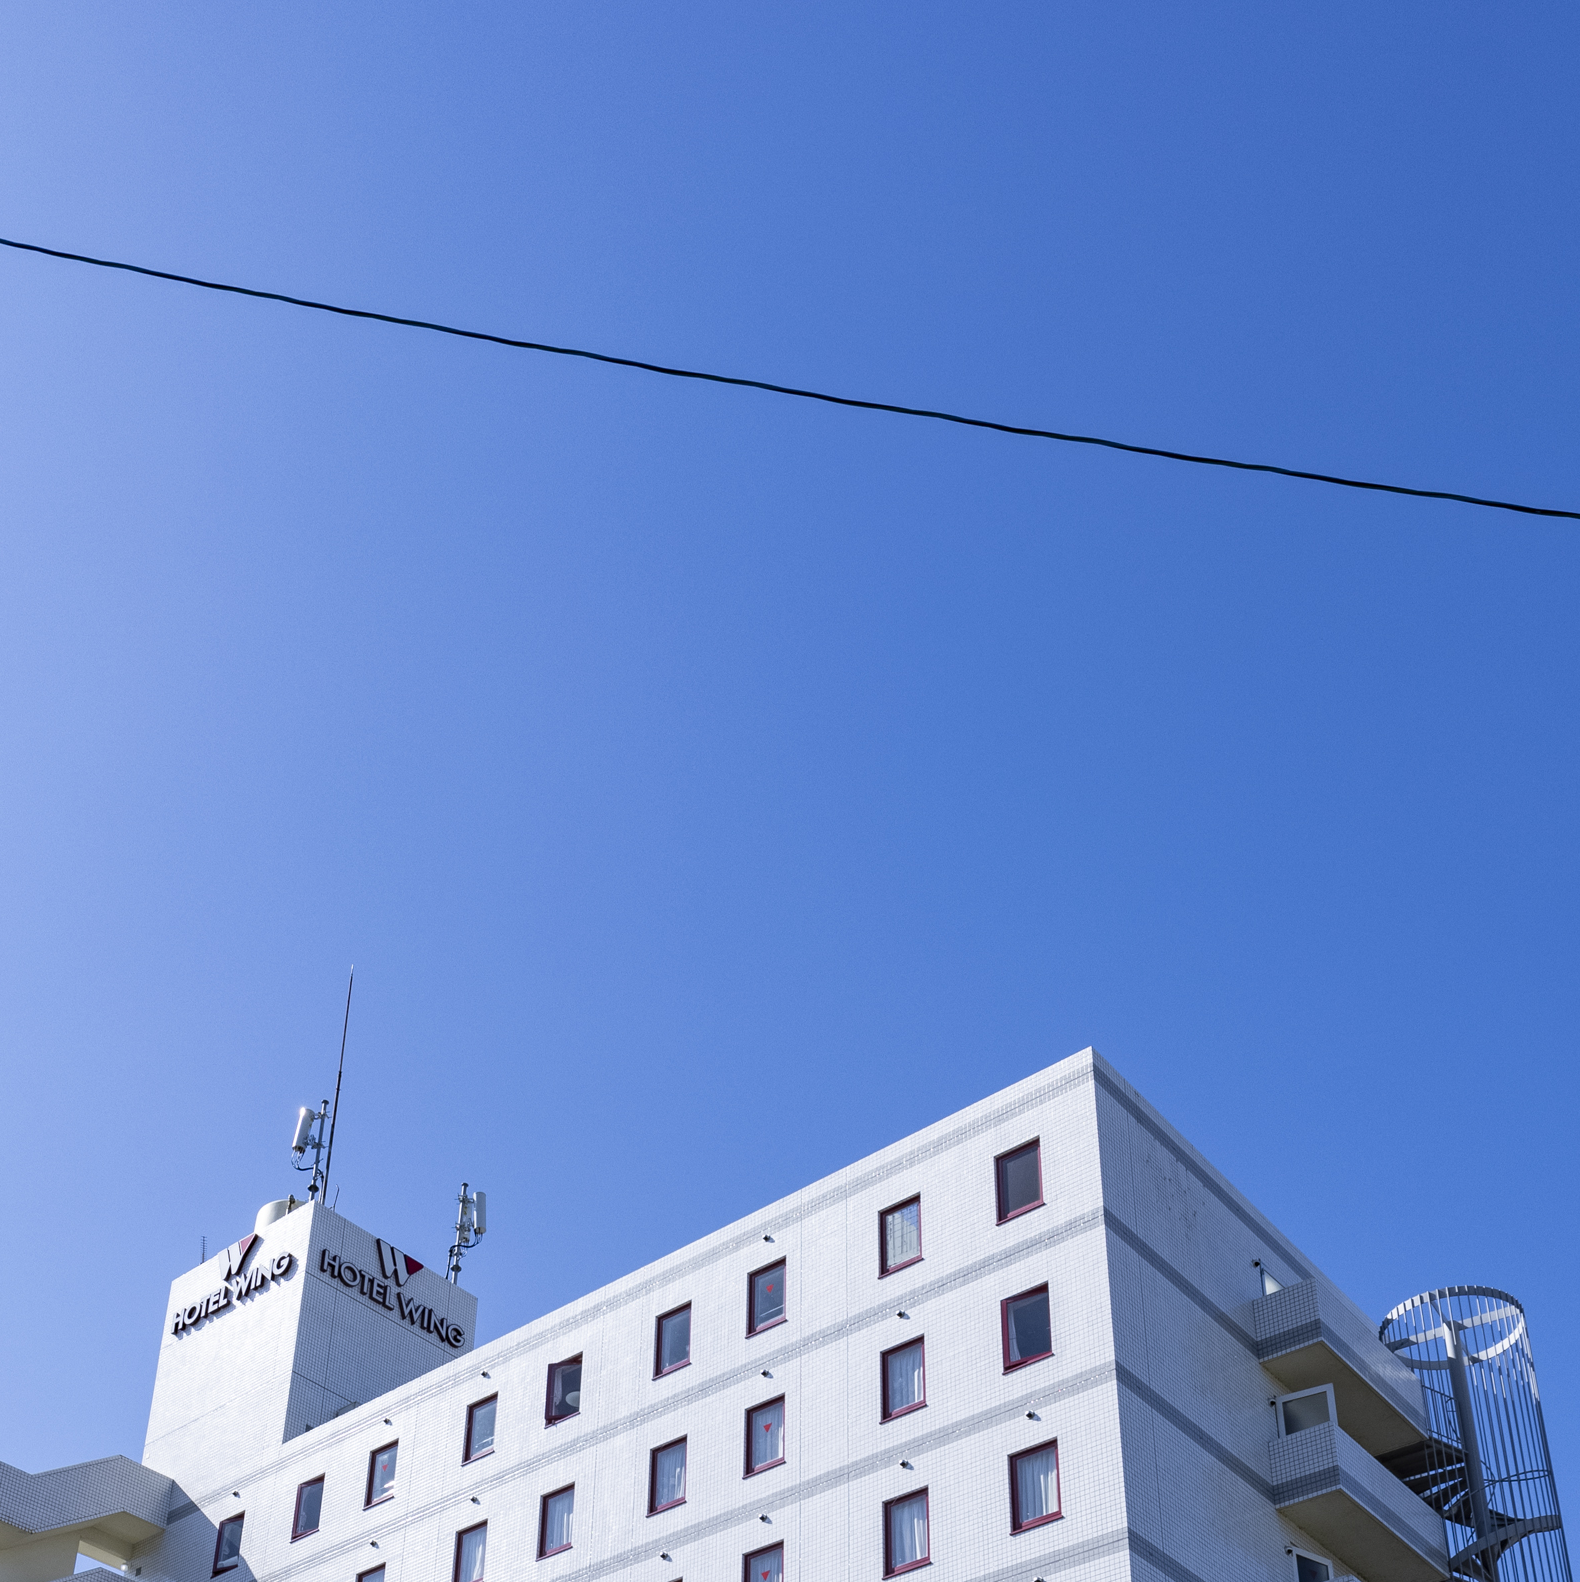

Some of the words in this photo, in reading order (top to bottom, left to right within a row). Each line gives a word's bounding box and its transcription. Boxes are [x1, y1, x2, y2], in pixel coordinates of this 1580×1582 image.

[171, 1286, 231, 1335] HOTEL
[232, 1251, 293, 1301] WING
[320, 1249, 395, 1311] HOTEL
[397, 1292, 466, 1349] WING
